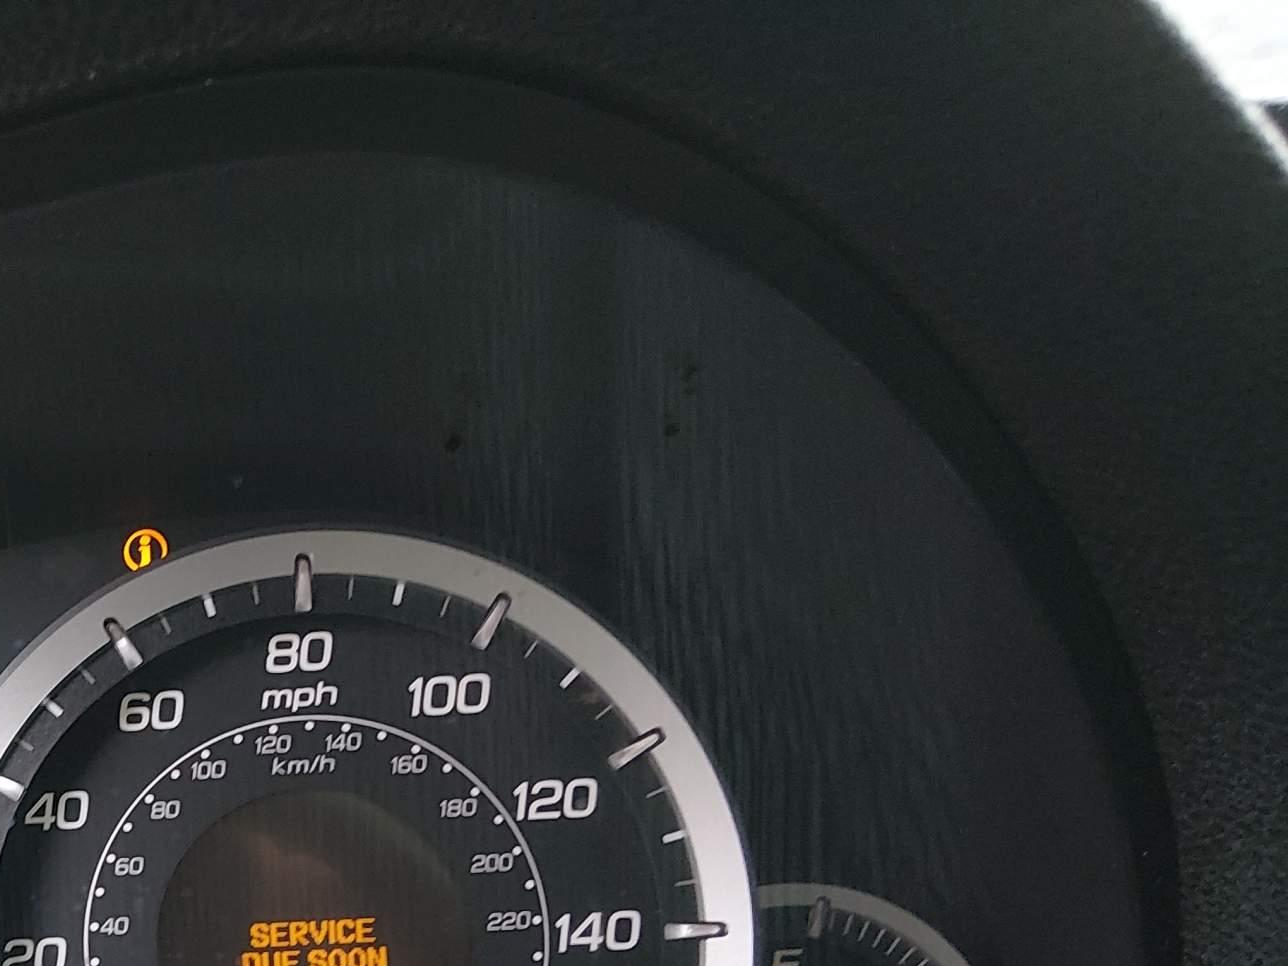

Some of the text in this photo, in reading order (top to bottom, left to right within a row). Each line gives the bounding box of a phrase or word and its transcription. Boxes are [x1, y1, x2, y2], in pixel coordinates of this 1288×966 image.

[265, 631, 333, 674] 80
[261, 680, 338, 712] mph
[408, 673, 491, 717] 100
[119, 690, 184, 732] 60
[254, 733, 292, 754] 120
[325, 732, 362, 753] 140
[190, 759, 227, 780] 100
[271, 754, 336, 776] km/h
[390, 754, 428, 775] 160
[25, 790, 89, 830] 40
[150, 799, 181, 820] 80
[439, 797, 478, 818] 180
[513, 777, 597, 821] 120
[114, 856, 145, 876] 60
[470, 852, 513, 874] 200
[99, 916, 130, 936] 40
[486, 910, 530, 932] 220
[554, 910, 641, 953] 140
[250, 917, 376, 951] SERVICE
